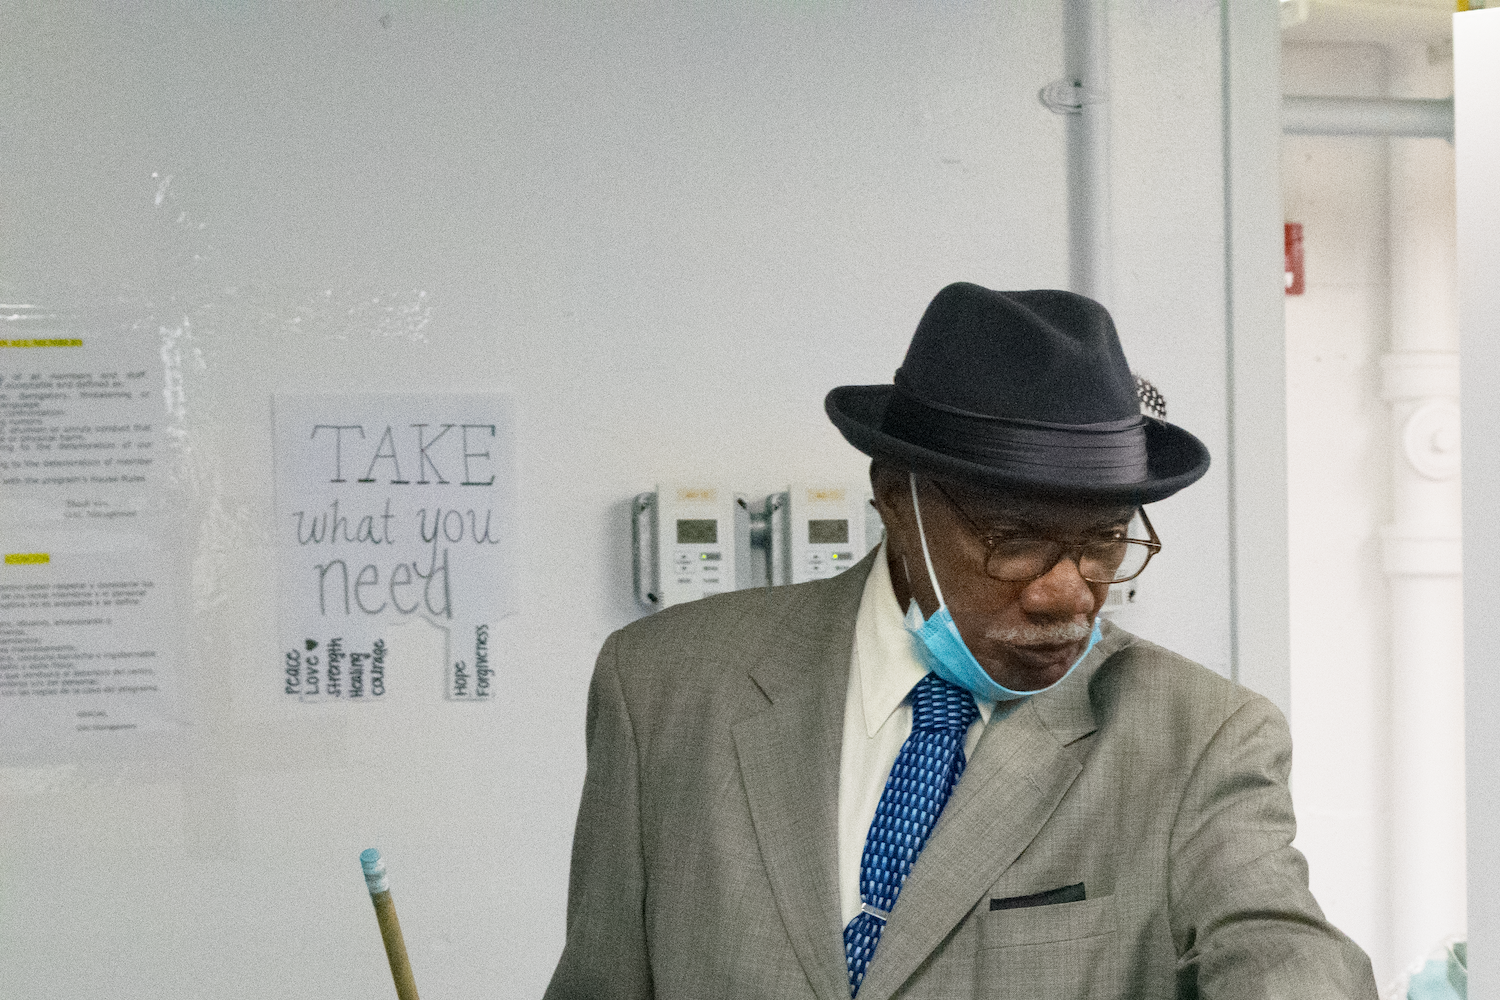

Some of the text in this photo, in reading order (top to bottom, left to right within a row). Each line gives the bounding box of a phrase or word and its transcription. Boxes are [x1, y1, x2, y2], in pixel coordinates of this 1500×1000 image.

[311, 423, 496, 486] TAKE
[292, 497, 500, 579] what you
[313, 548, 453, 620] need
